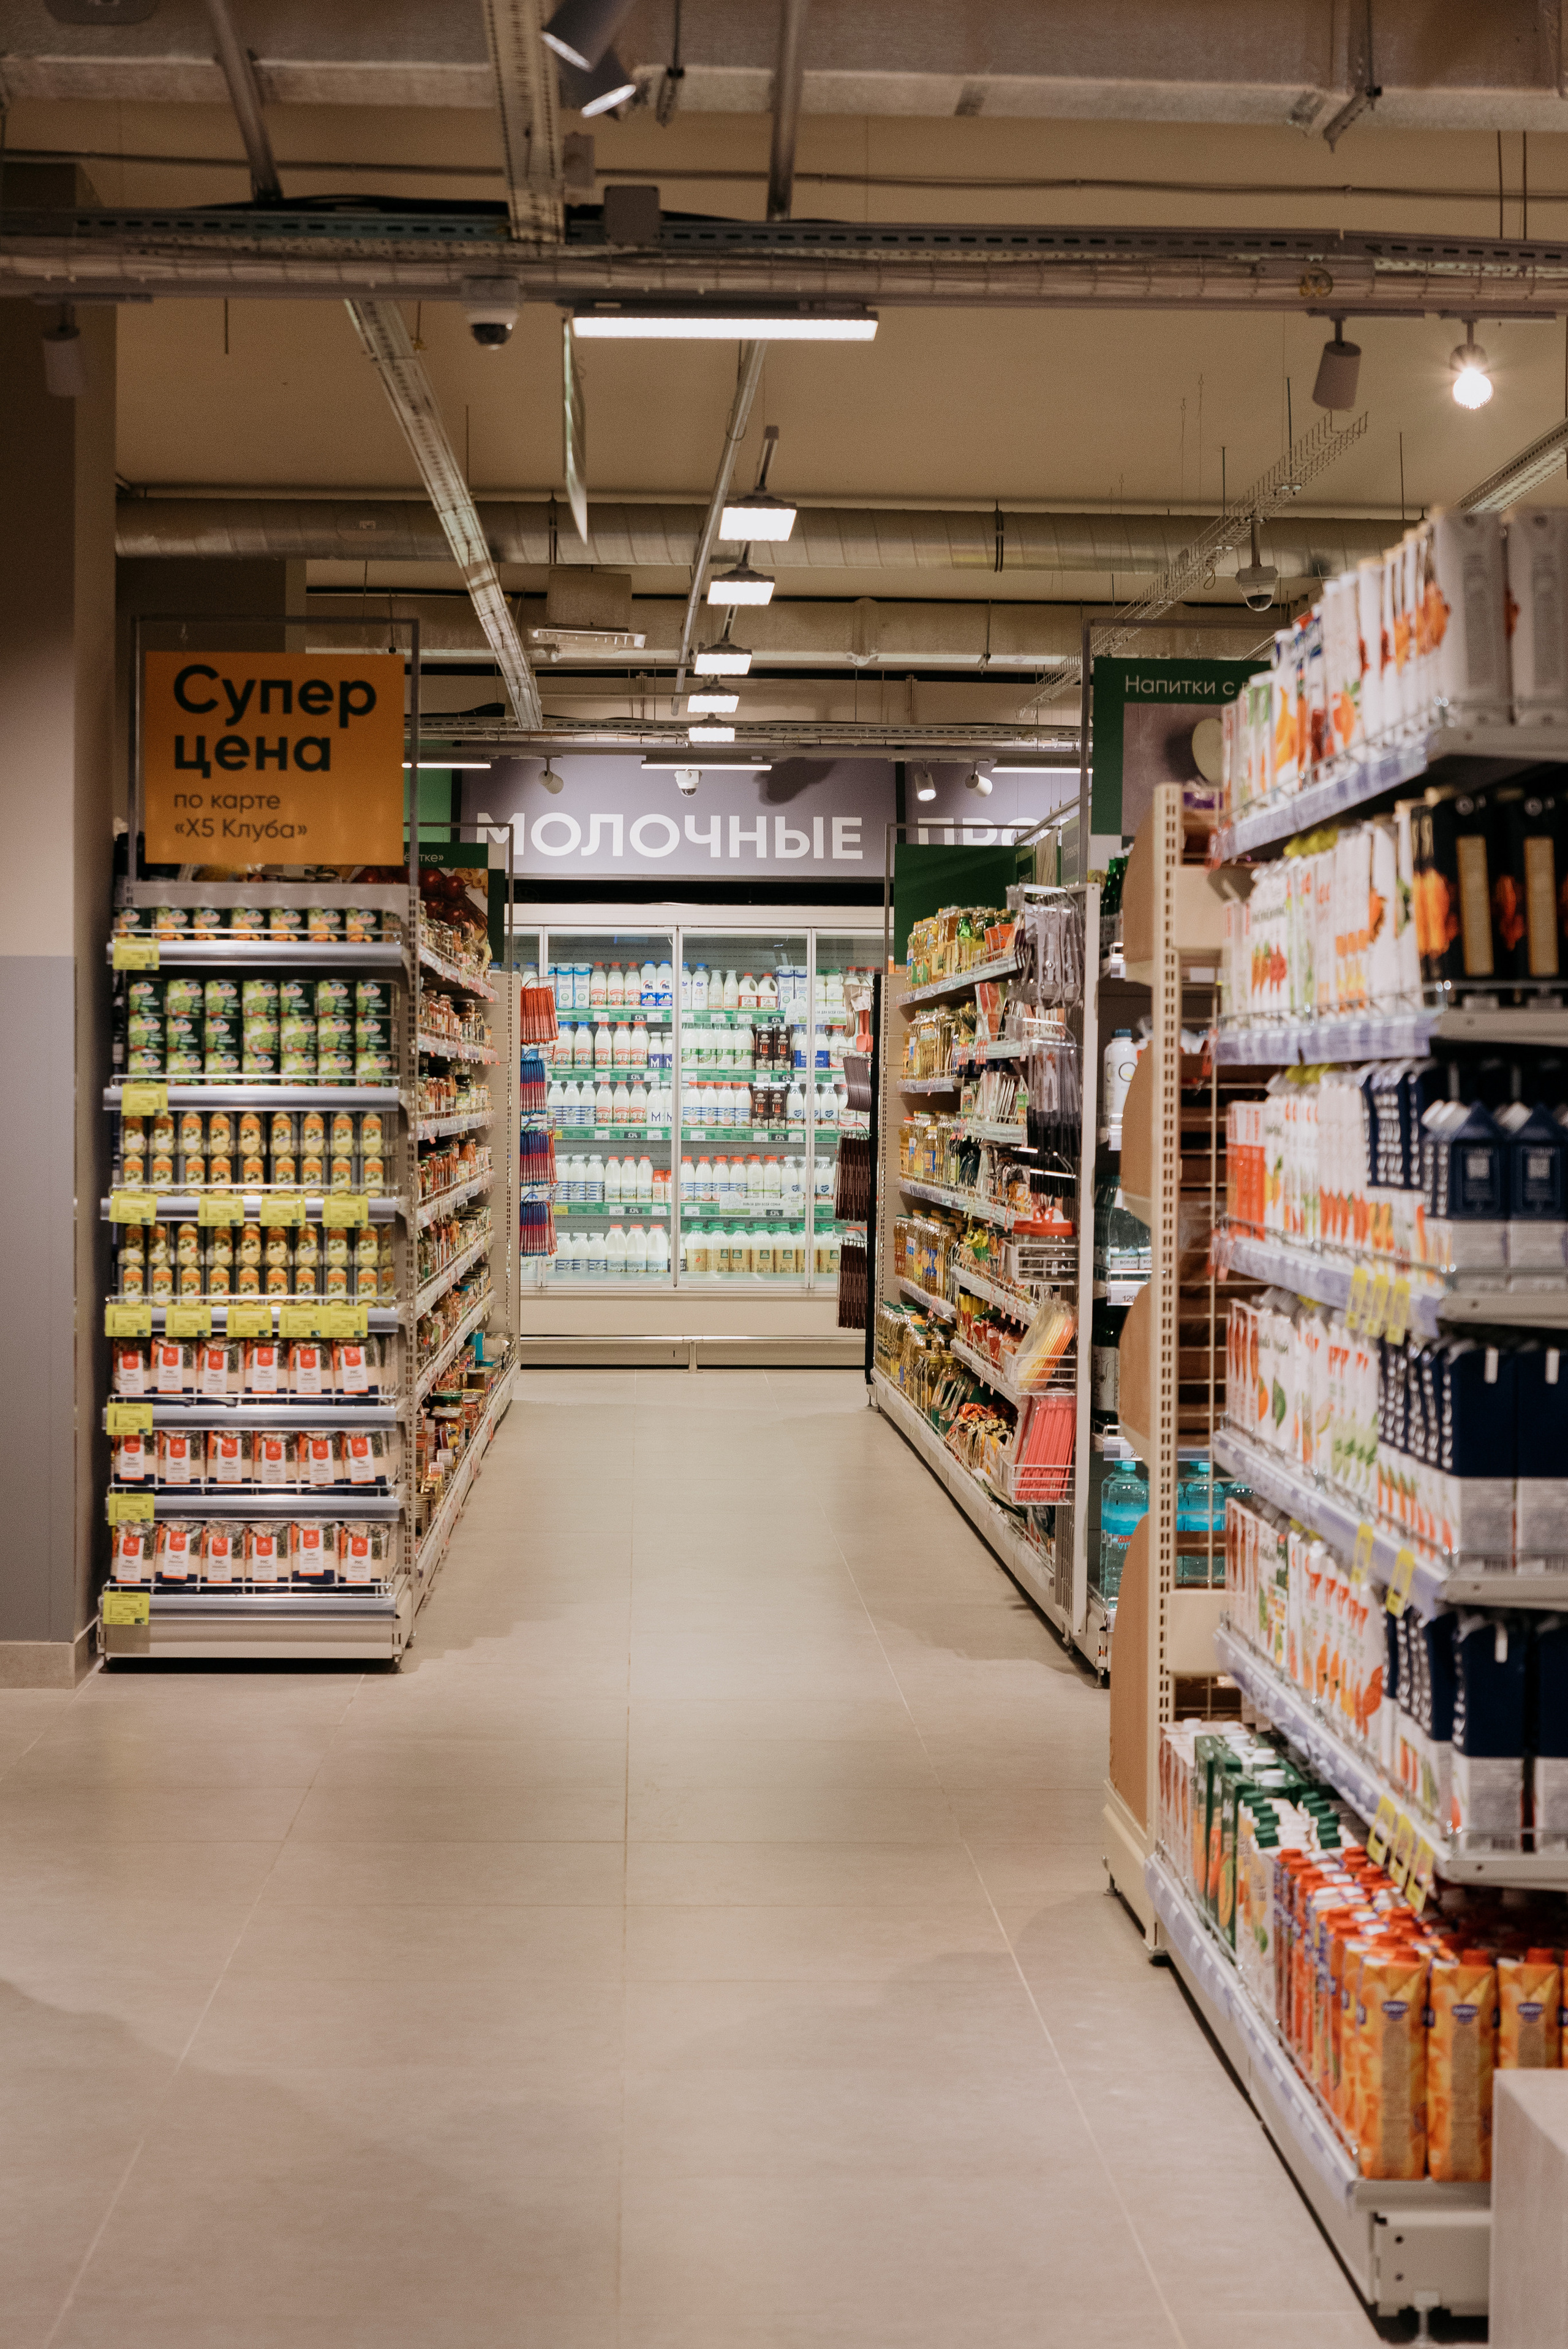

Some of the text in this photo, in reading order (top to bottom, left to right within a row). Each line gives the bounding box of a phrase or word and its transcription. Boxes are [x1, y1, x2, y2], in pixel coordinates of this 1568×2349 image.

[173, 665, 376, 728] Супер
[1125, 675, 1216, 695] Напитки
[1222, 681, 1234, 695] с
[175, 735, 330, 778] цена
[175, 794, 281, 812] по карте
[222, 819, 307, 842] Клуба»
[477, 812, 863, 859] МОЛОЧНЫЕ
